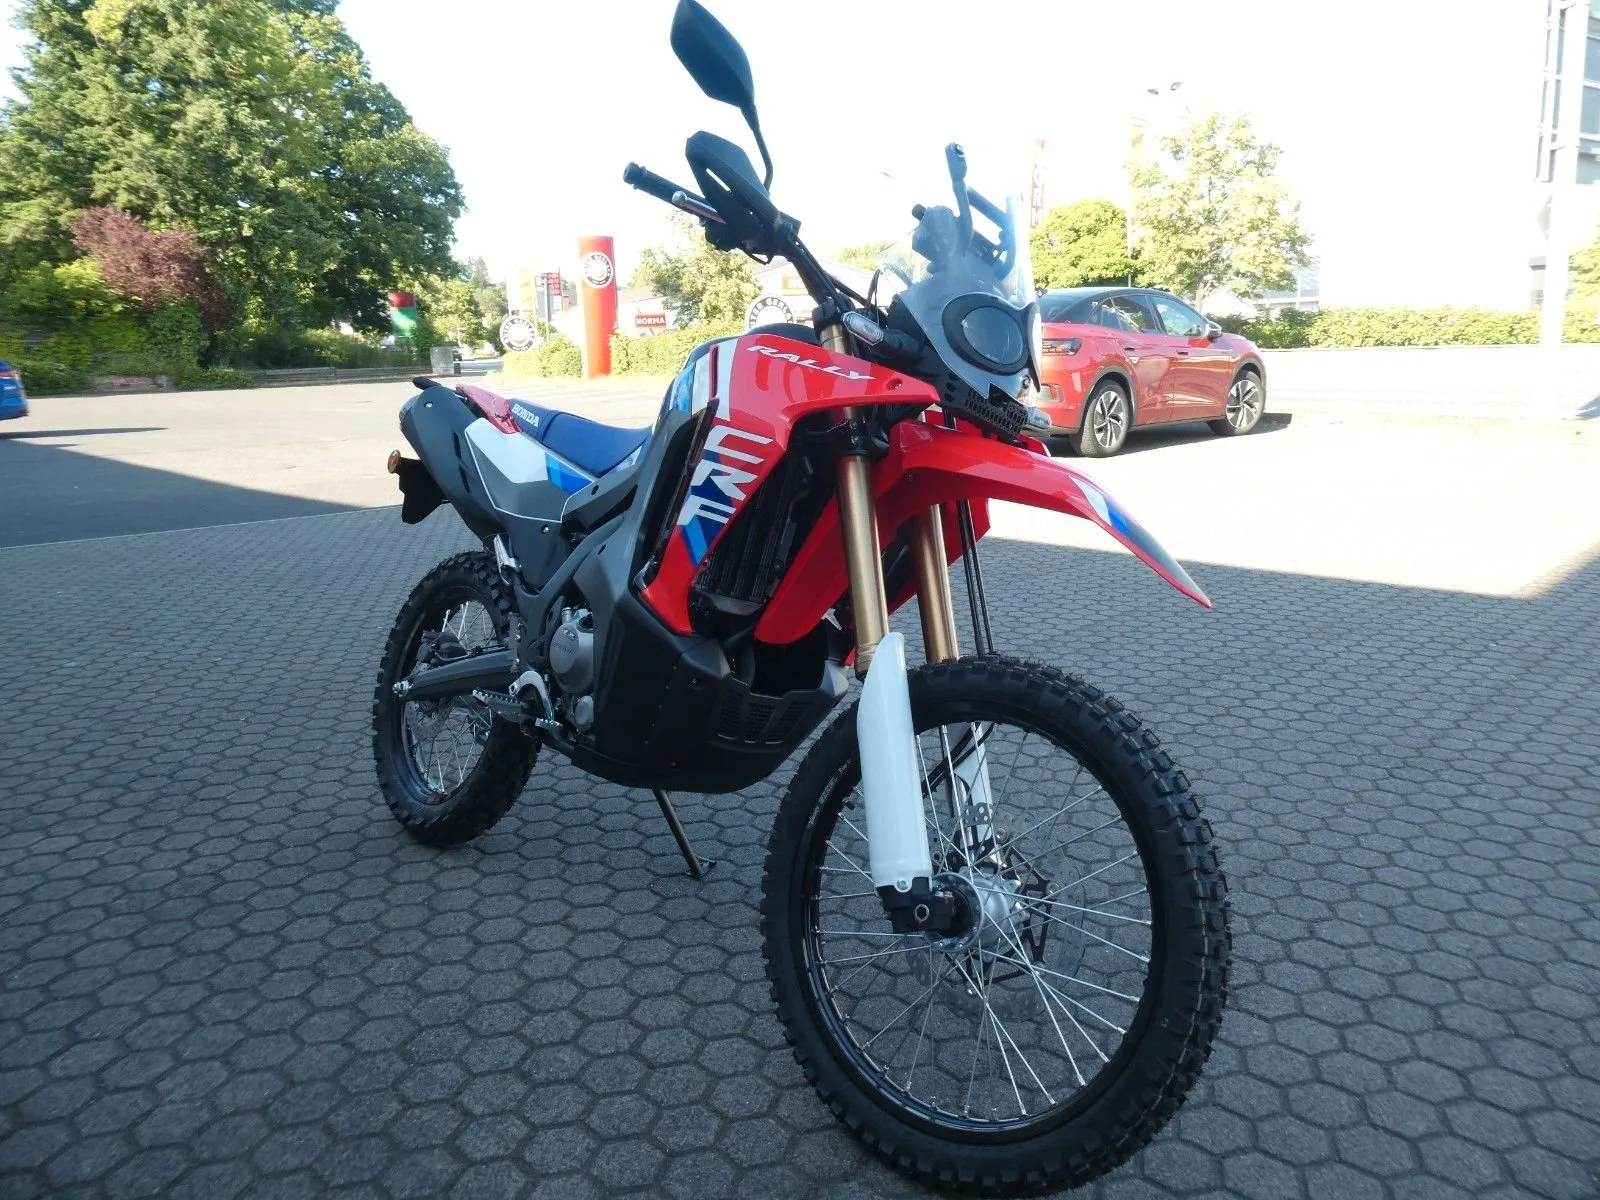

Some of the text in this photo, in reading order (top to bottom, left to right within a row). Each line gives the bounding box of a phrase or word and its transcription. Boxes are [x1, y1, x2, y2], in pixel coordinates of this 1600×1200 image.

[636, 317, 665, 325] NORMA
[746, 345, 877, 380] RALLY
[511, 403, 540, 428] HONDA
[677, 424, 774, 526] CRF
